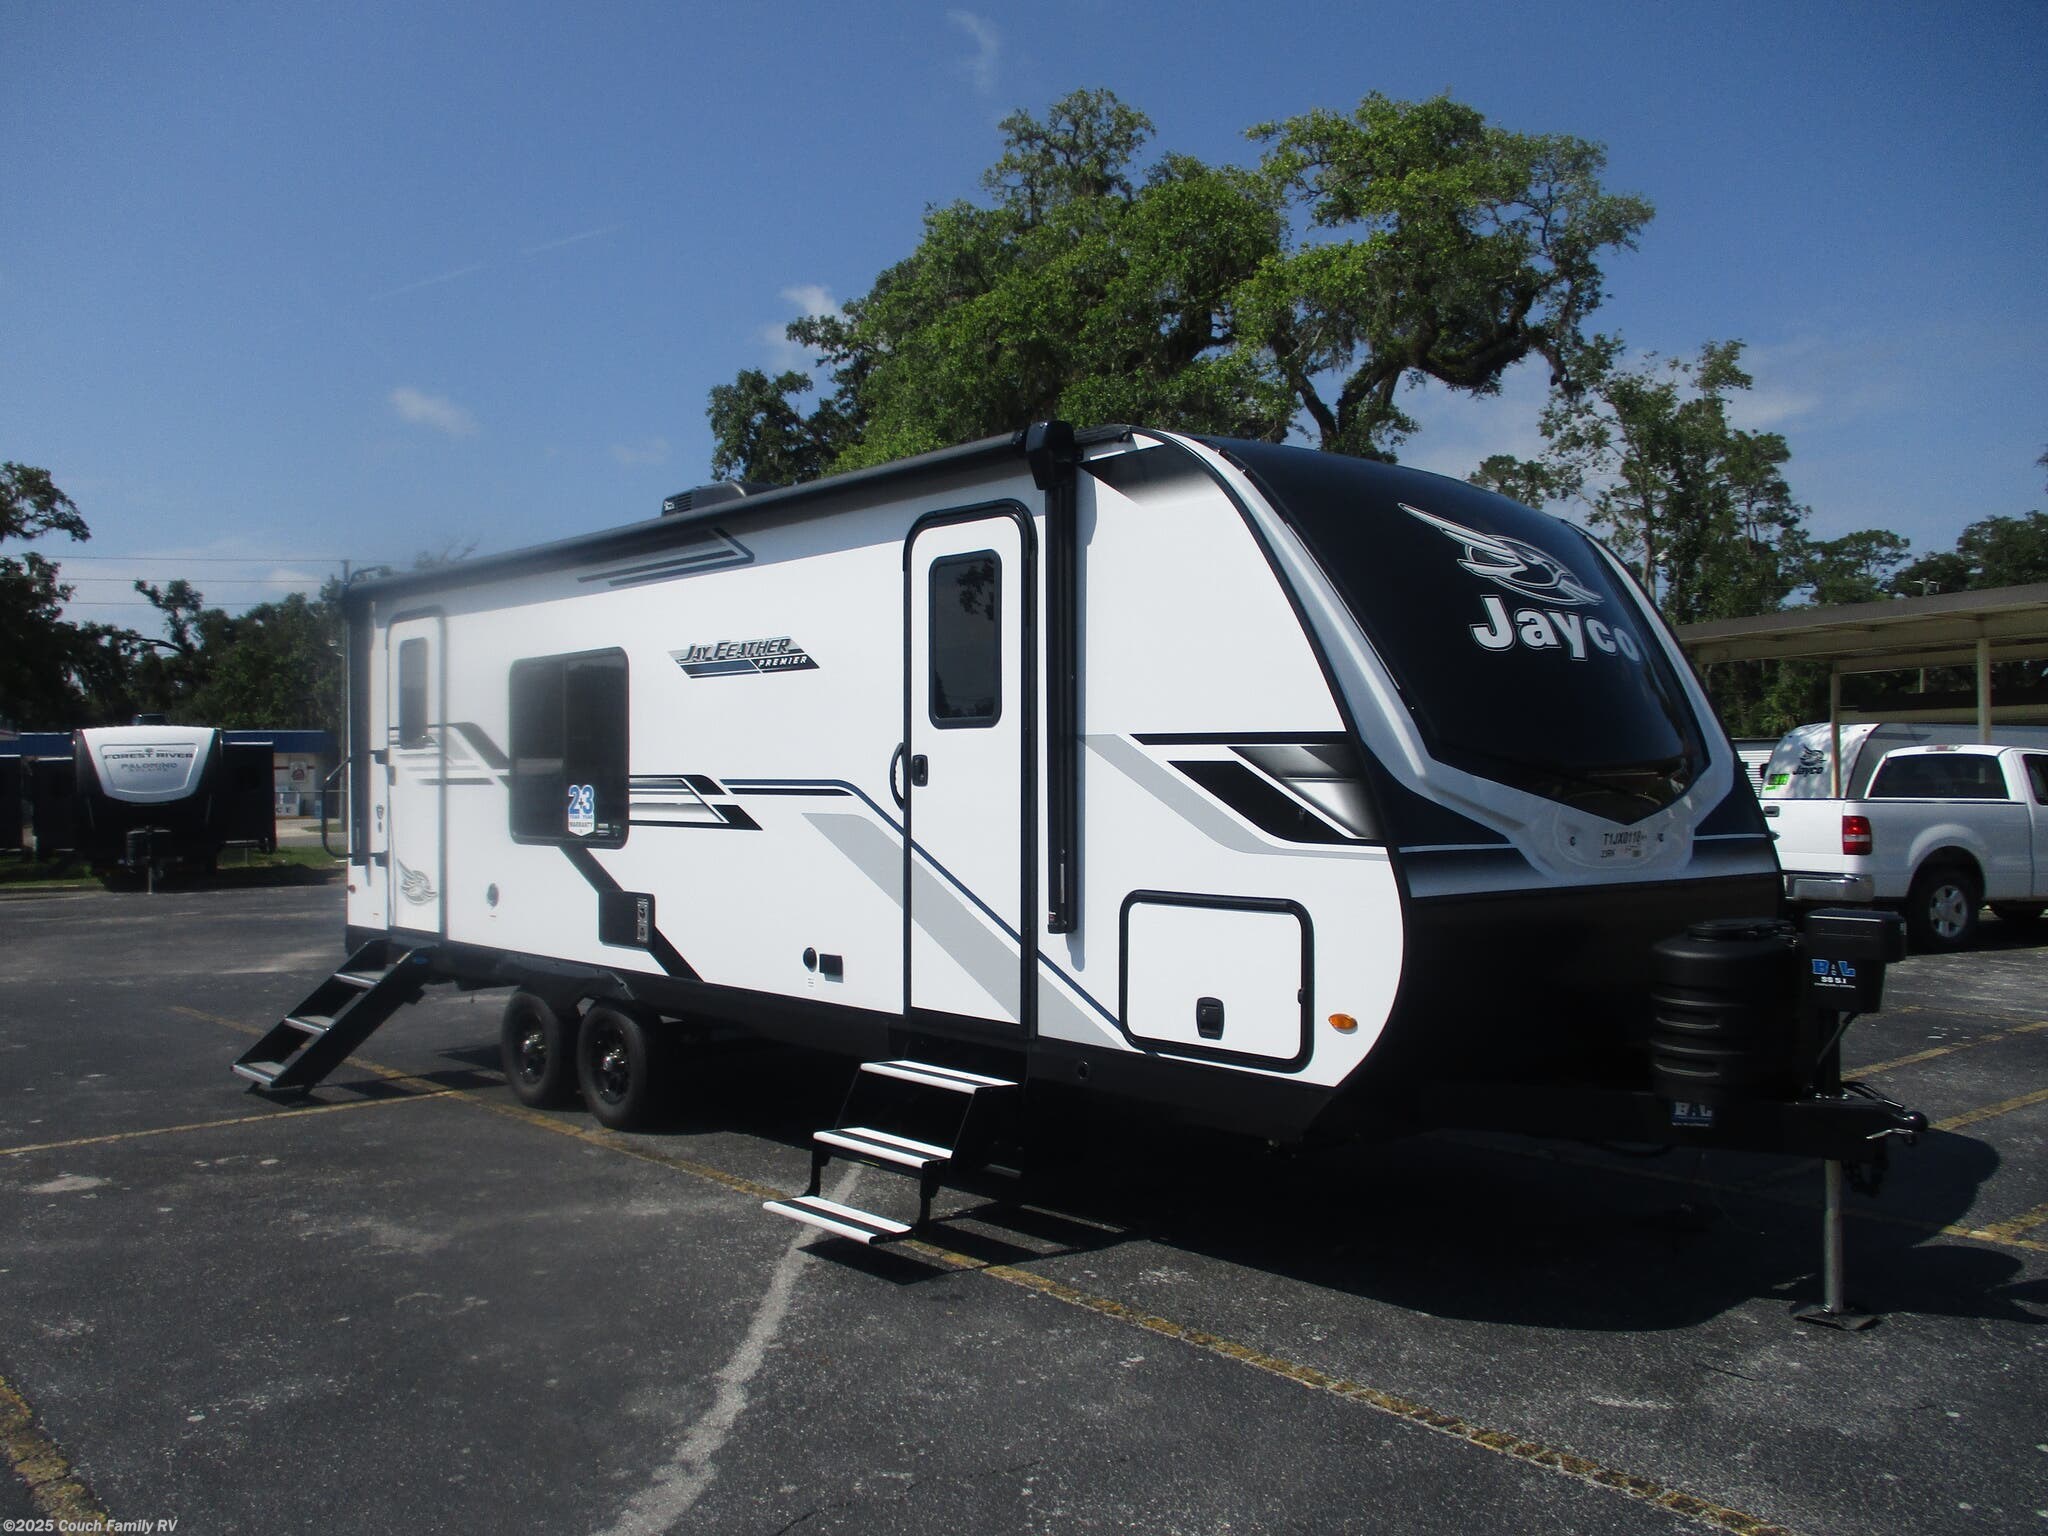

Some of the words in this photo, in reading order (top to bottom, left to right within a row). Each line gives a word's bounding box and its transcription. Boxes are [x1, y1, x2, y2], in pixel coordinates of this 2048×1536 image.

[1469, 594, 1641, 664] Jayco
[713, 636, 792, 659] FEATHER
[757, 655, 808, 668] PREMIER
[104, 752, 152, 760] FOREST
[1792, 765, 1824, 777] Jayco
